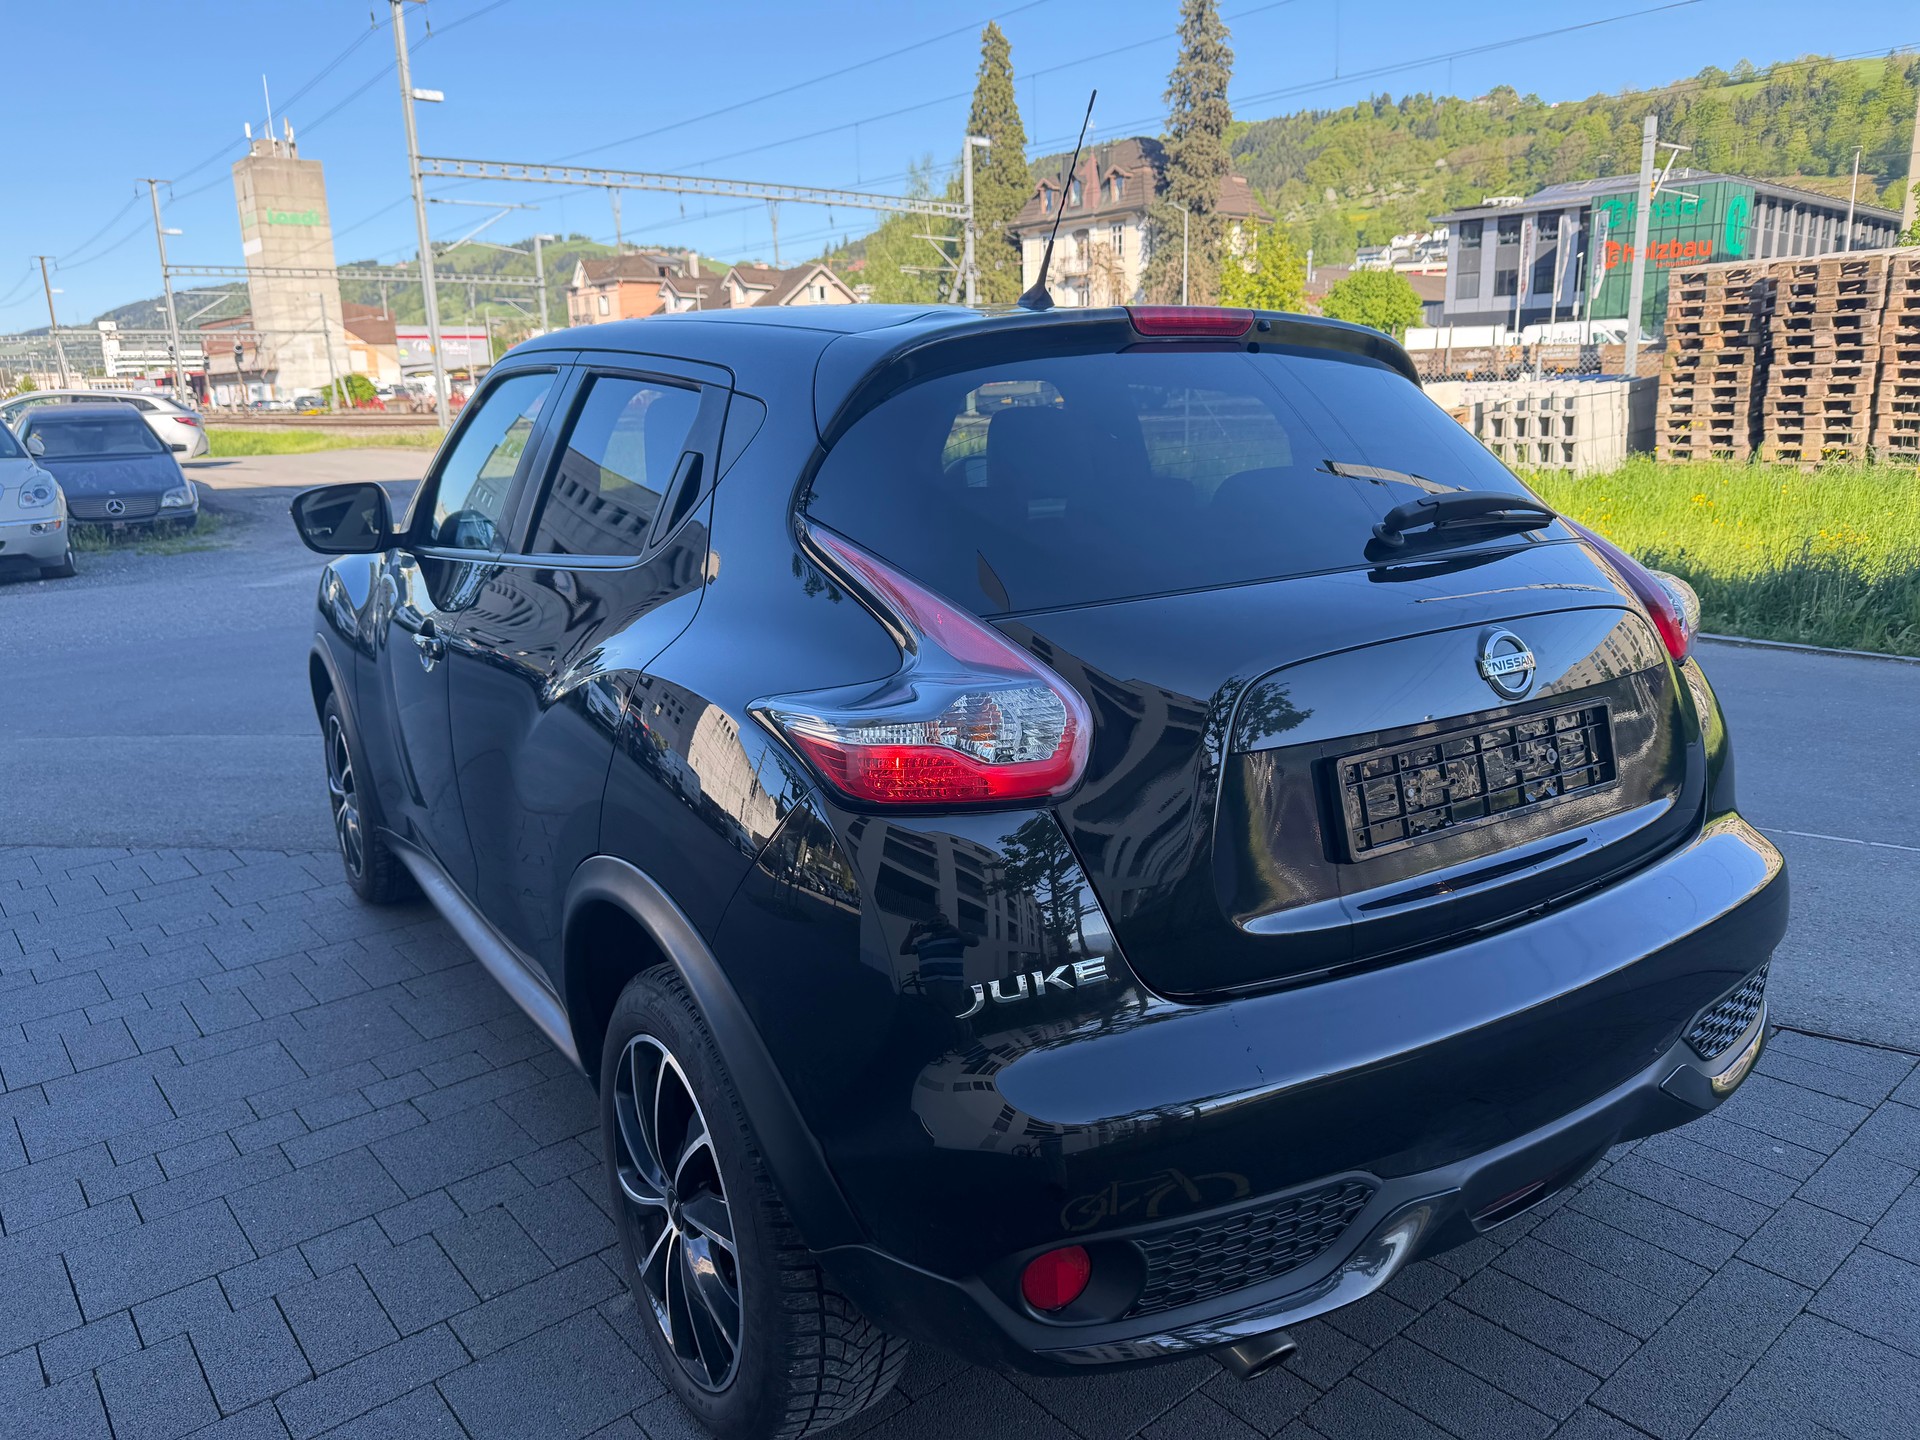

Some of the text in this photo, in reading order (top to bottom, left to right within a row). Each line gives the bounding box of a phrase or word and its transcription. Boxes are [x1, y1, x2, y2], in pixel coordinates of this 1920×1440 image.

[1626, 196, 1707, 221] fnster
[1492, 654, 1533, 672] NISSAN
[955, 956, 1109, 1019] JUKE
